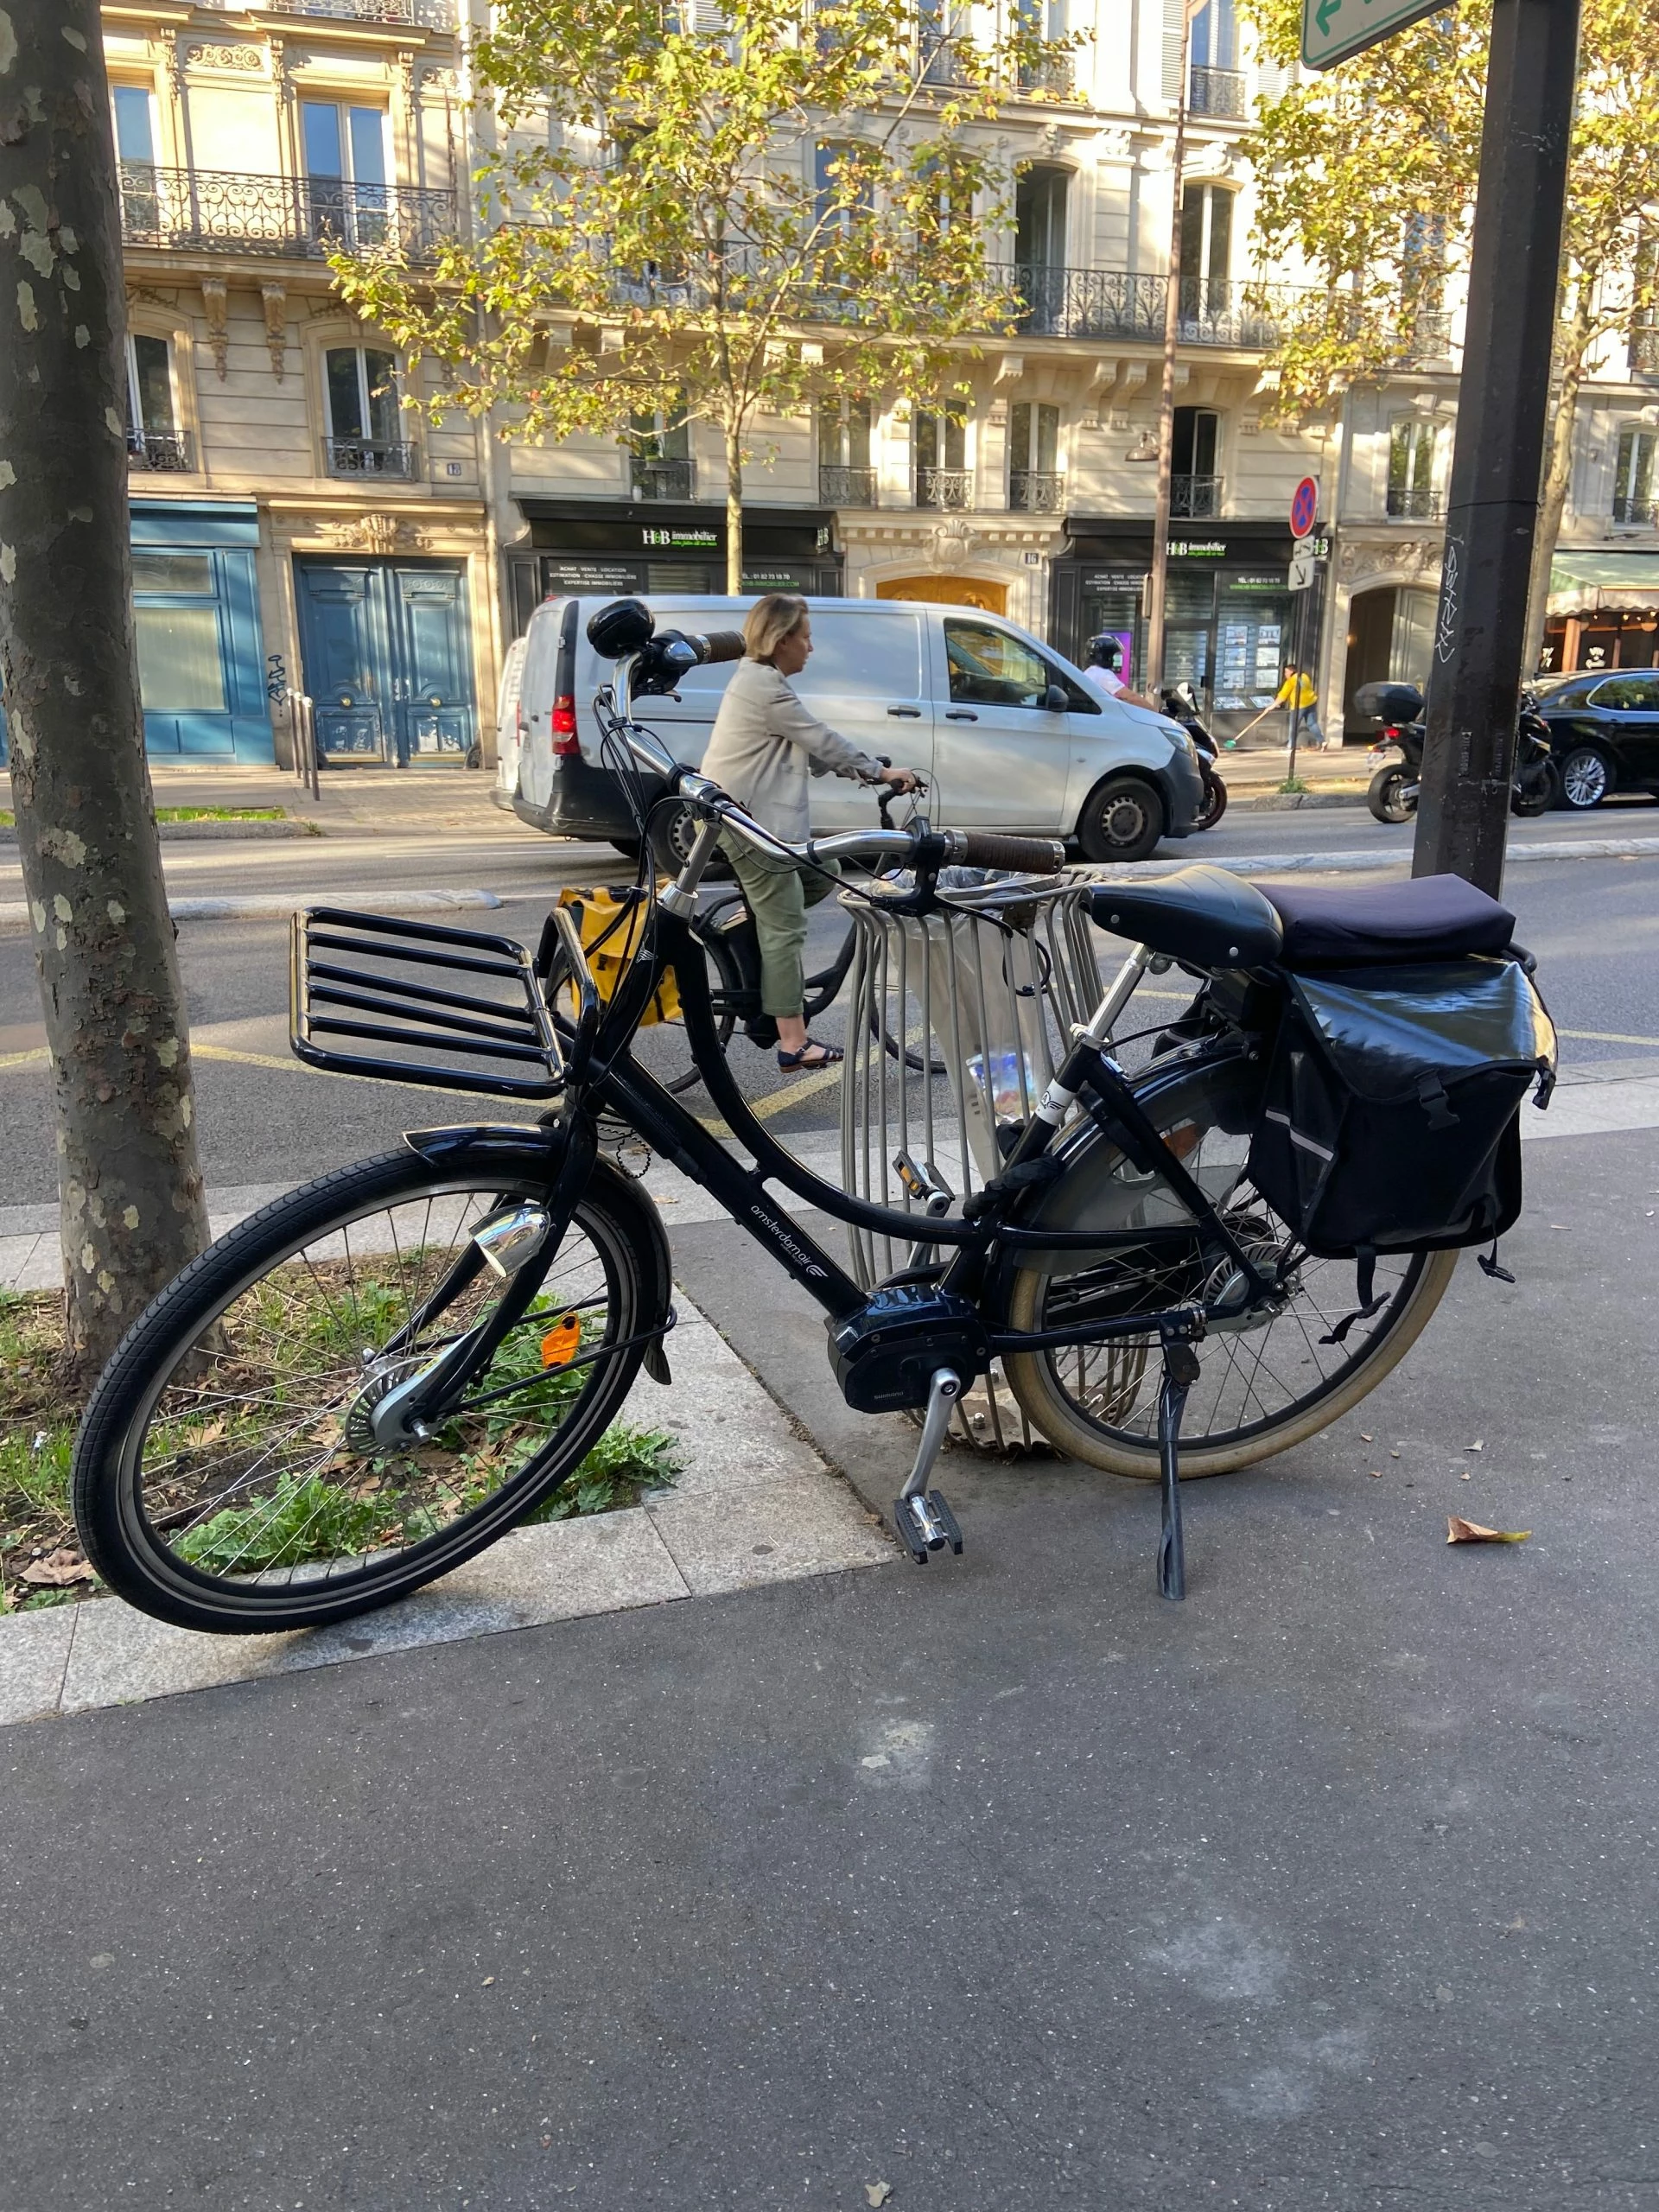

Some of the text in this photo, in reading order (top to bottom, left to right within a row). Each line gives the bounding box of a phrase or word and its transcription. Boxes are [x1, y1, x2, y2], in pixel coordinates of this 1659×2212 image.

[671, 530, 718, 541] immobilier
[1188, 542, 1226, 552] immobilier
[1027, 553, 1037, 564] 16
[750, 1205, 801, 1255] amsterdam
[798, 1253, 813, 1265] air
